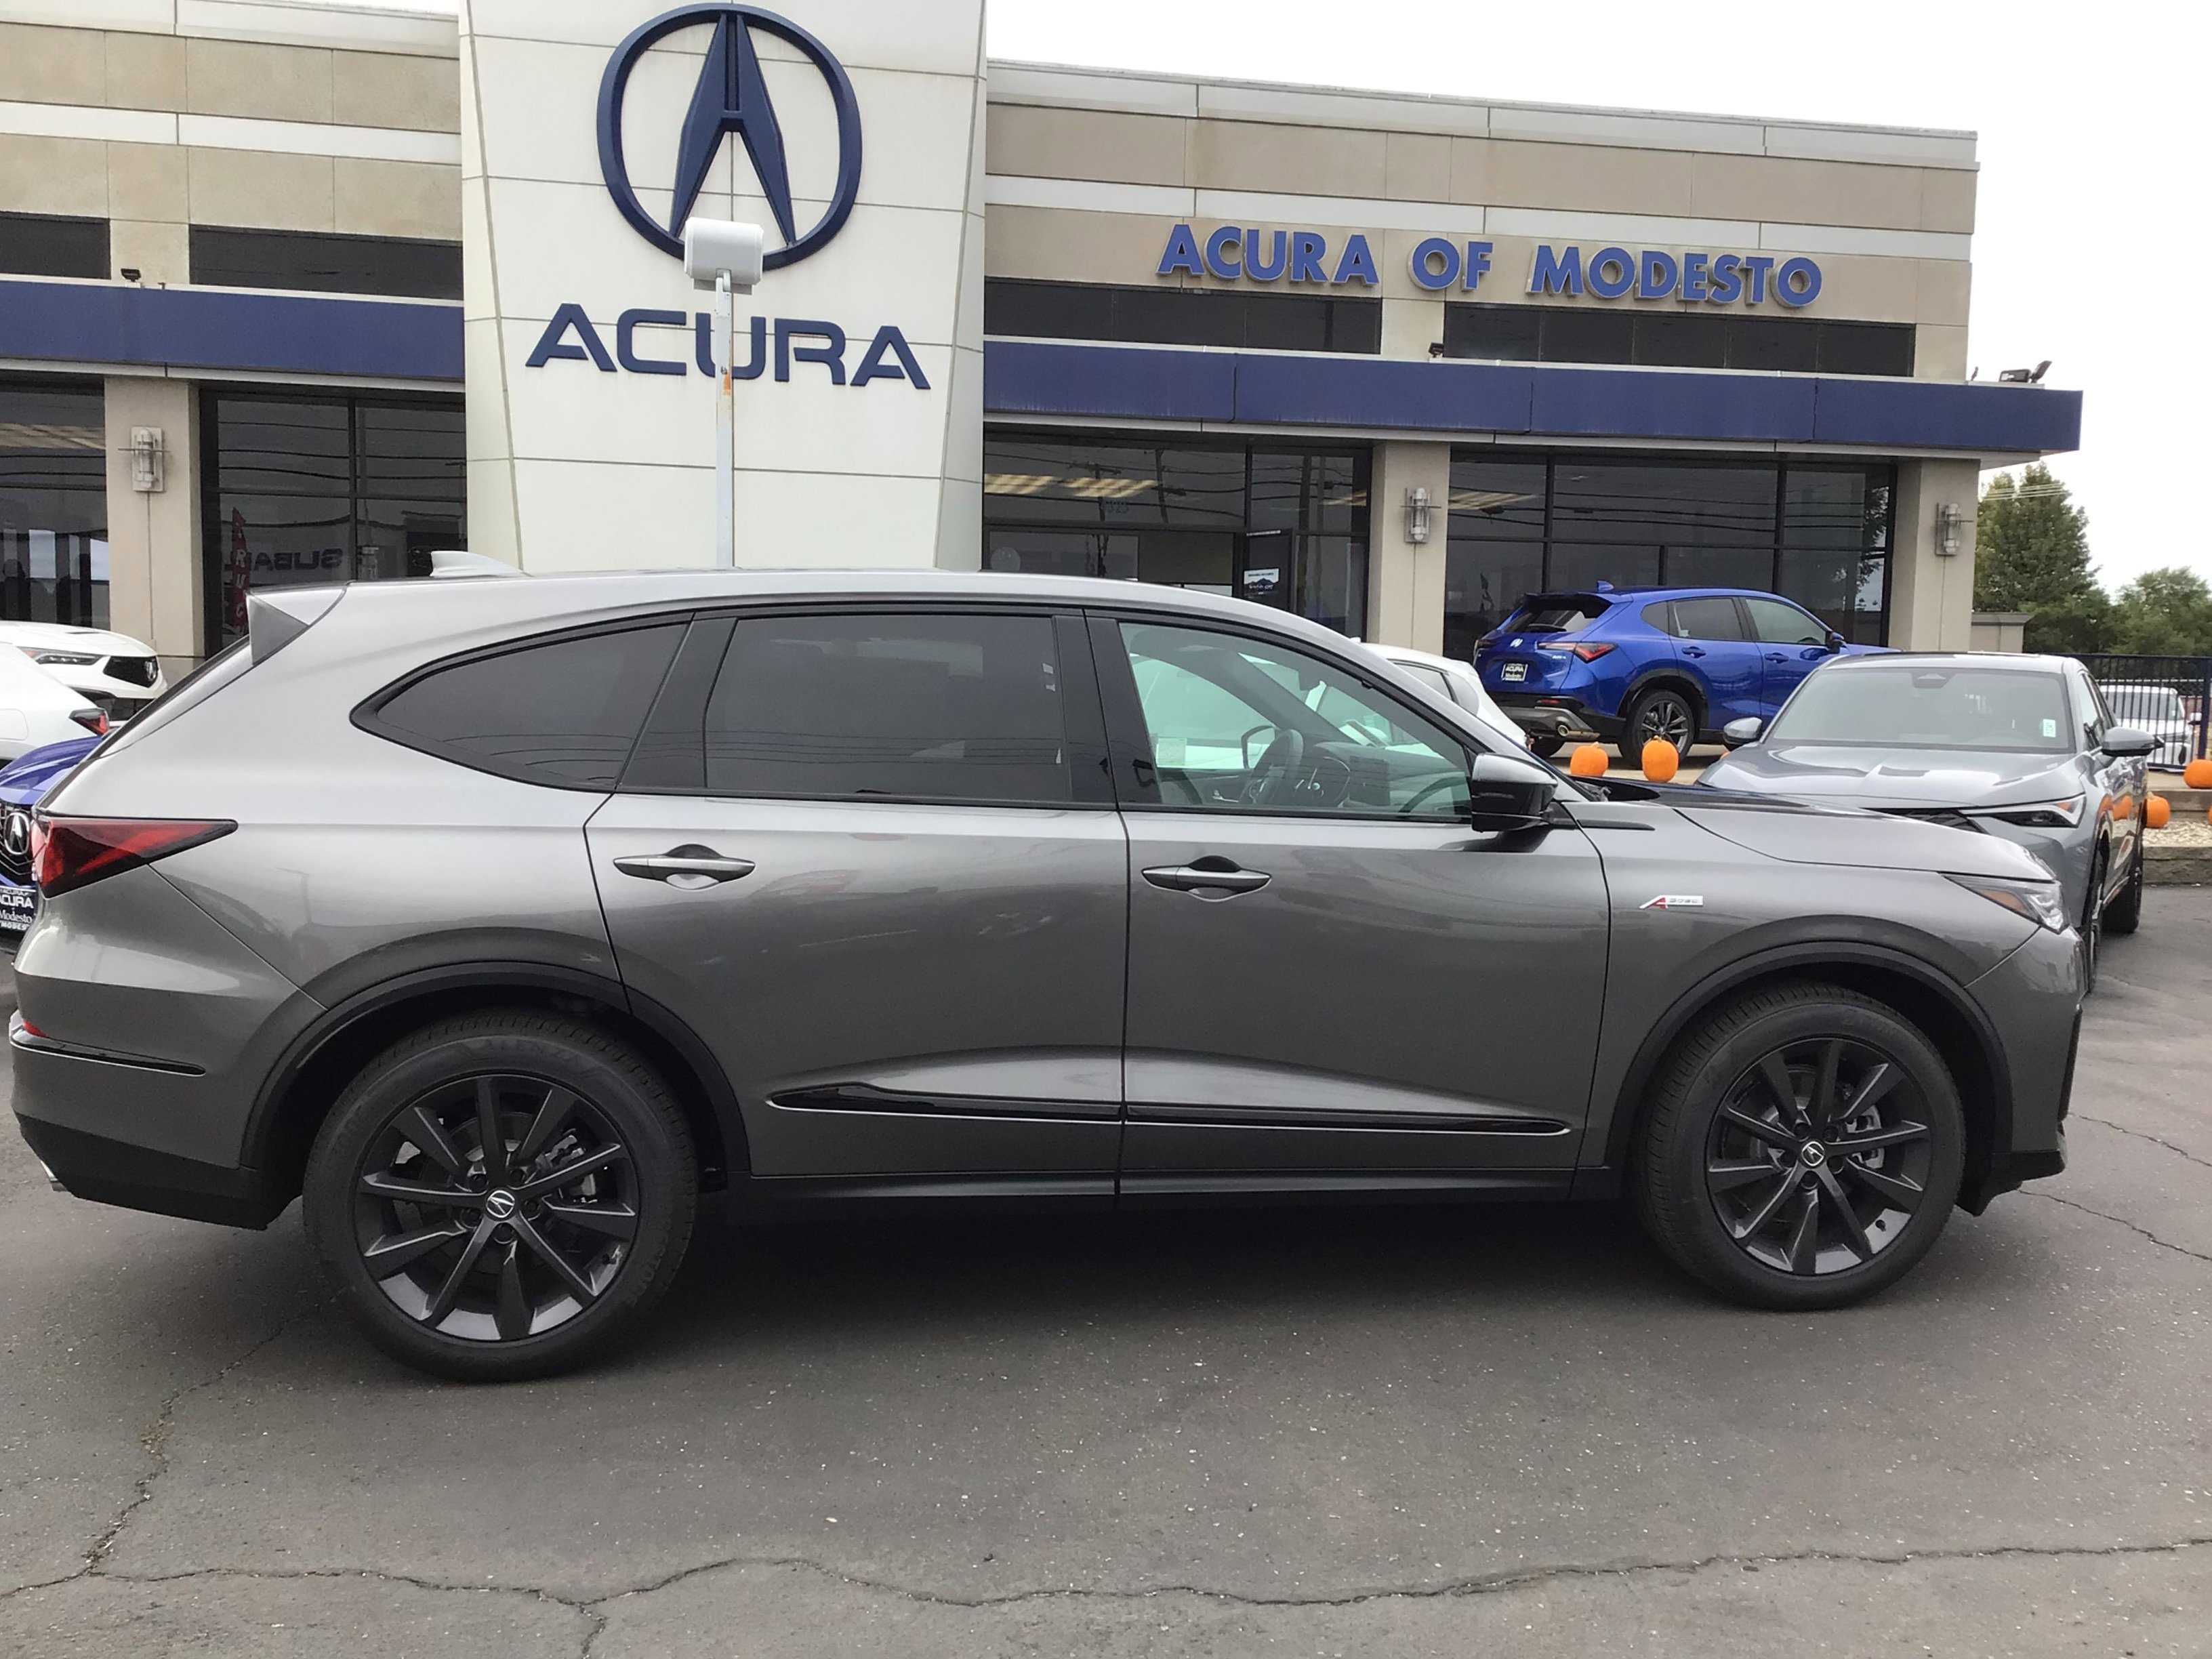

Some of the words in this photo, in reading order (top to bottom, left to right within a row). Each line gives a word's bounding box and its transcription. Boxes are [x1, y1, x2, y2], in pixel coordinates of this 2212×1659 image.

[1156, 224, 1380, 285] ACURA
[1409, 237, 1494, 291] OF
[1527, 245, 1822, 308] MODESTO
[525, 303, 930, 389] ACURA
[0, 894, 34, 909] CURA
